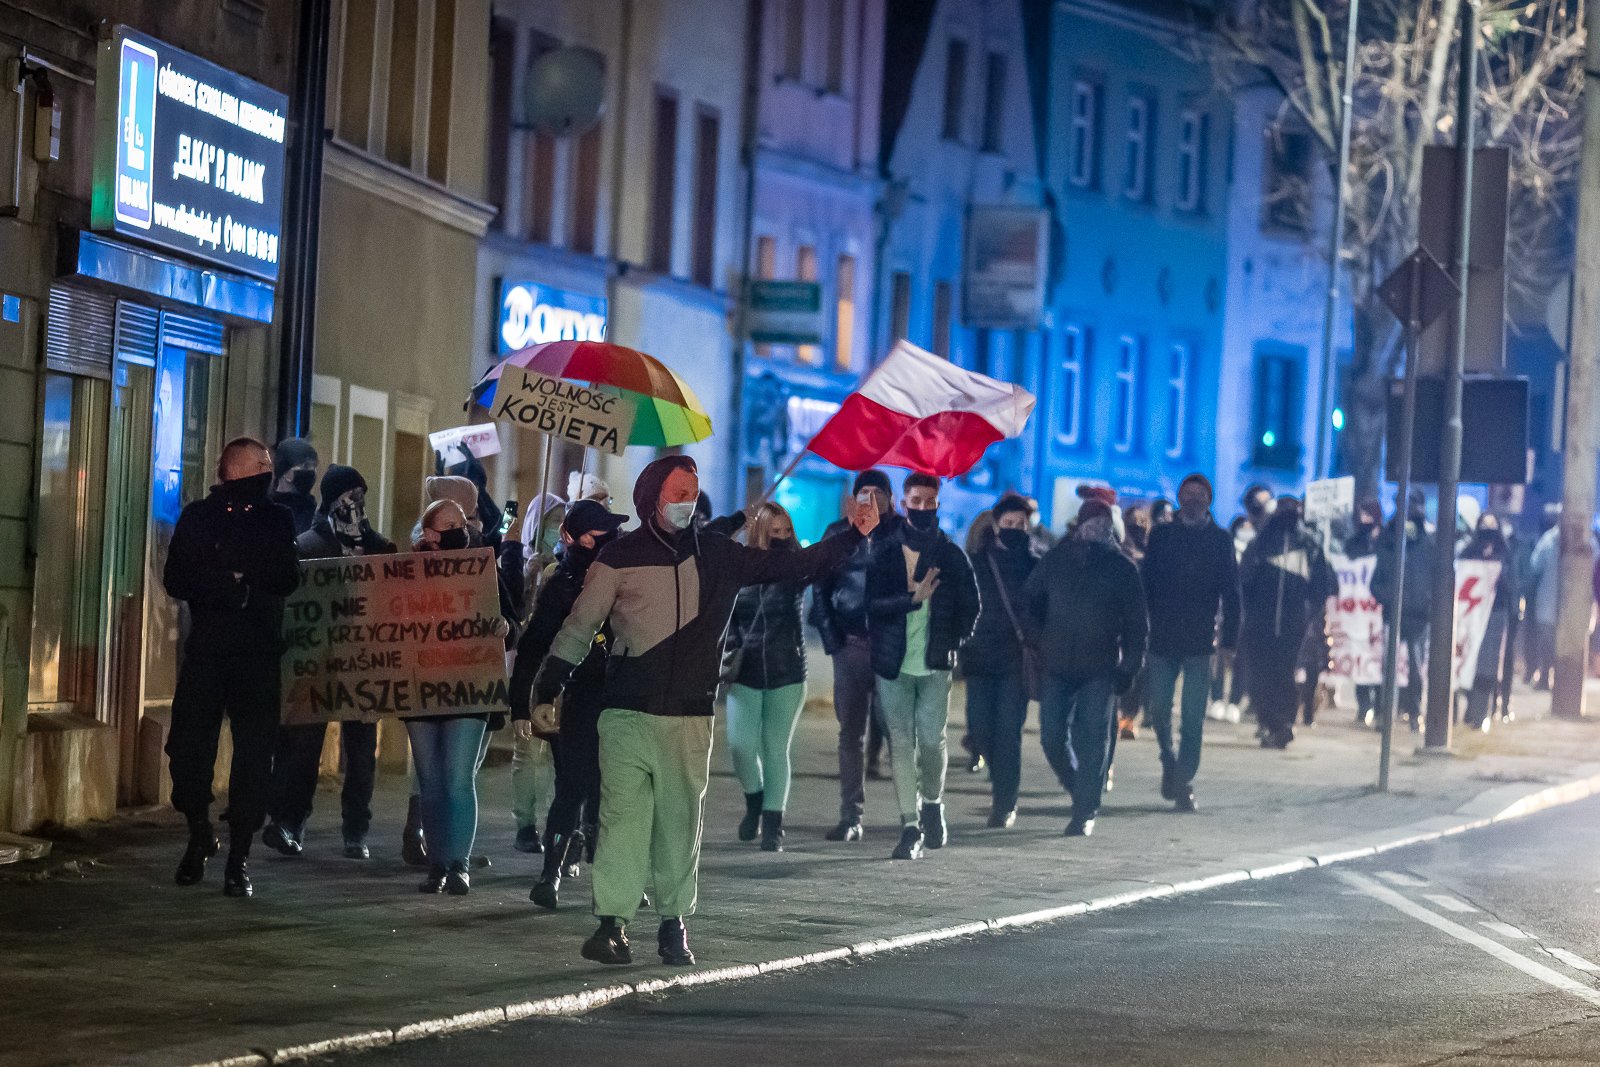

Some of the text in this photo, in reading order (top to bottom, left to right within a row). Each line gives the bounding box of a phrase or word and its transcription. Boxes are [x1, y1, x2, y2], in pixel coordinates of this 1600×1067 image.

[521, 373, 618, 414] WOLNOŚĆ
[537, 395, 580, 414] JEST
[314, 563, 376, 588] OFIARA
[383, 560, 416, 579] NIE
[287, 589, 476, 622] TO NIE GWAŁT
[327, 622, 431, 647] KRZYCZMY
[294, 658, 320, 677] BO
[326, 648, 402, 673] WŁAŚNIE
[309, 679, 510, 714] NASZE PRAWA
